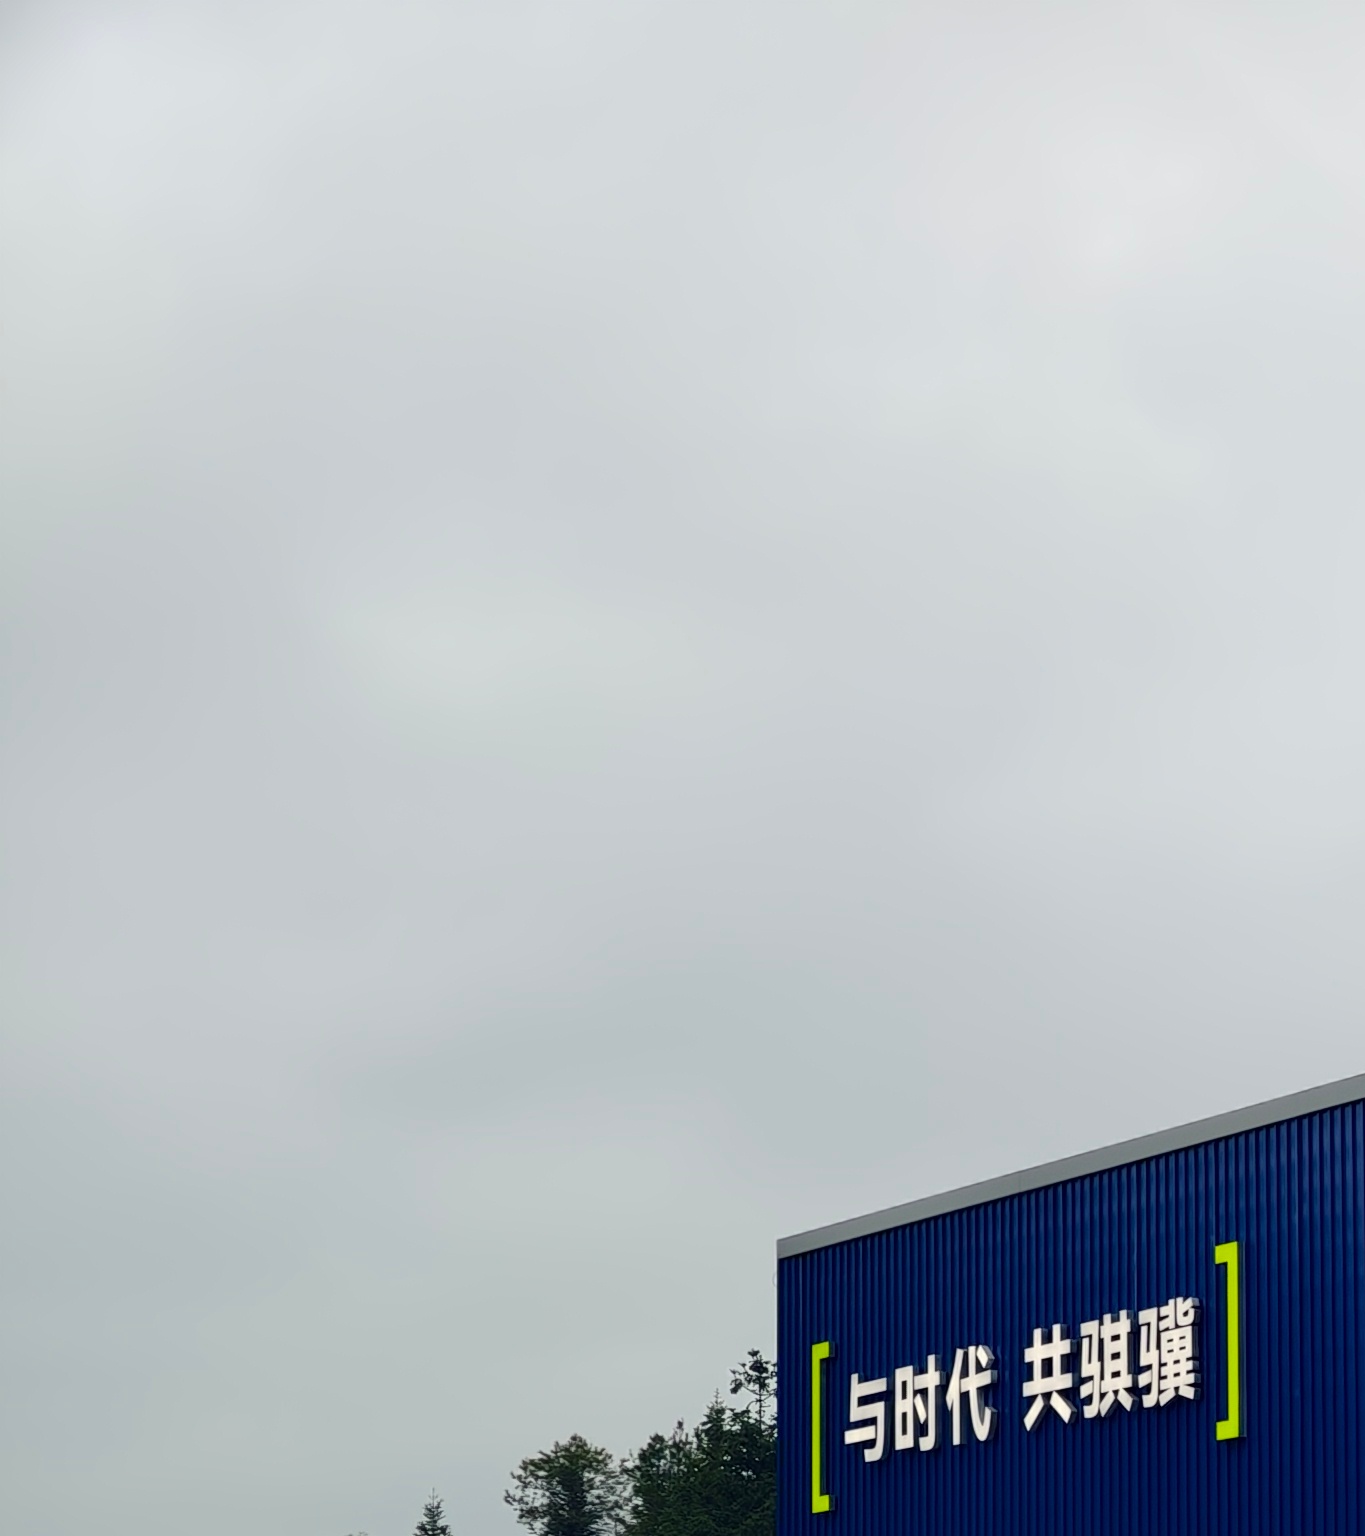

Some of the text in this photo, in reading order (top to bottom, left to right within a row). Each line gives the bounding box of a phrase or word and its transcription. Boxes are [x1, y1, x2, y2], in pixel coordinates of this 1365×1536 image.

[844, 1296, 1201, 1463] 与时代 共骐骥
